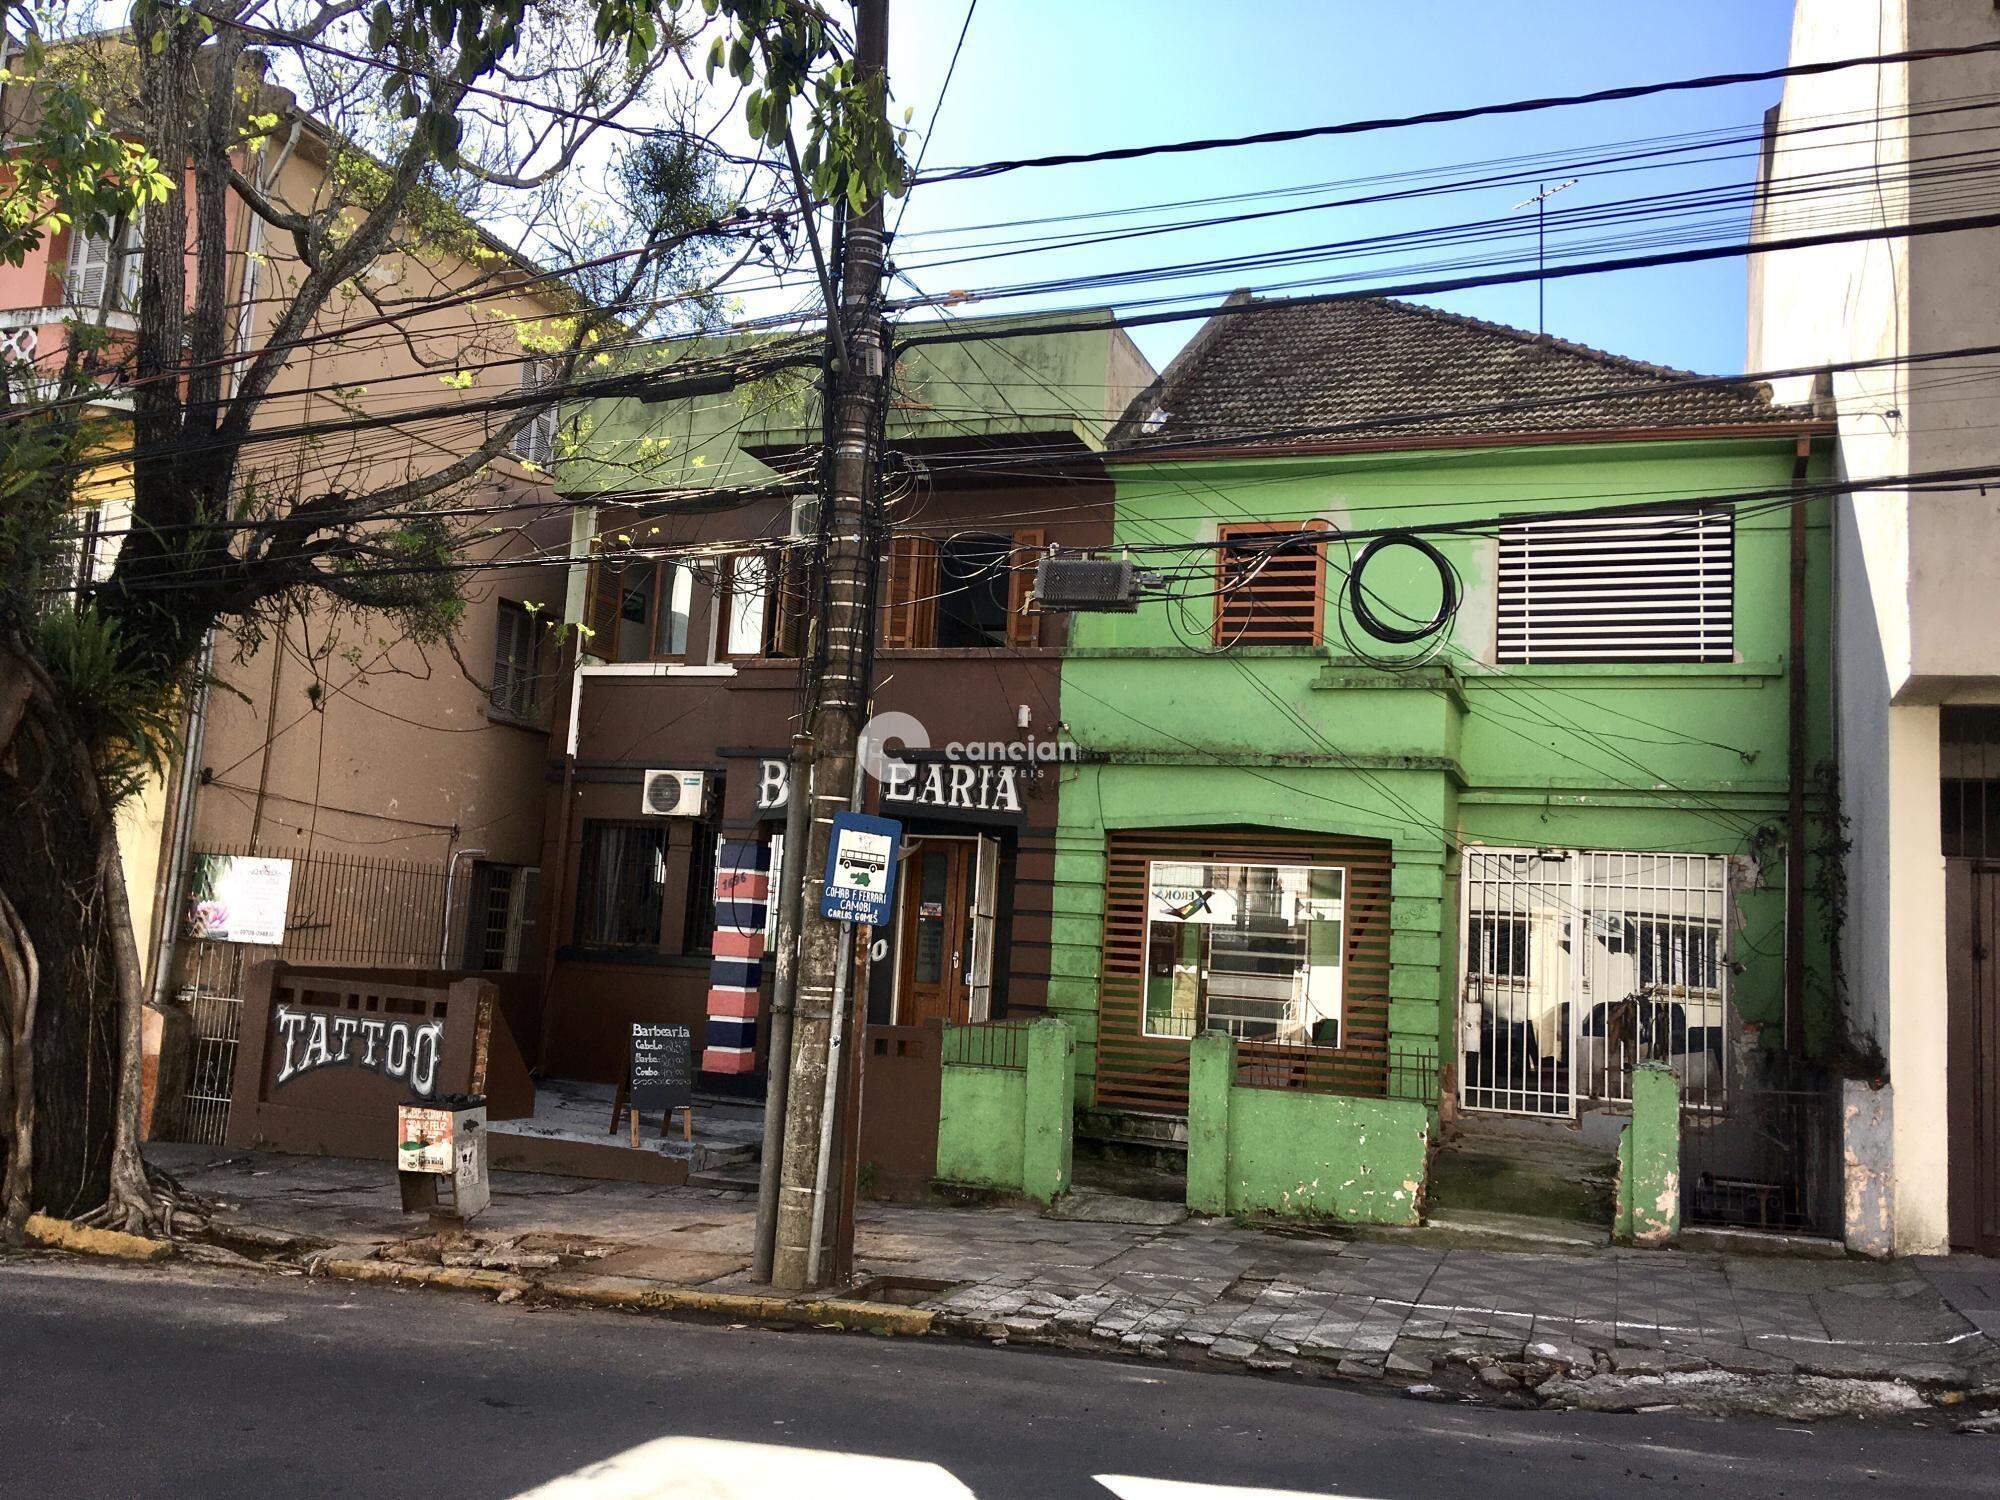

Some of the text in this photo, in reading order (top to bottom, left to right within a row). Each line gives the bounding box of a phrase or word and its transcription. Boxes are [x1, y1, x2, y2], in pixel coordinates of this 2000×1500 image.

[757, 760, 1021, 811] BEARIA
[859, 891, 887, 904] FERRARI
[840, 899, 871, 912] CAMOBI
[827, 908, 878, 924] CARLOS GOMES
[632, 1023, 690, 1037] Barbearia
[277, 1008, 443, 1095] TATTOO
